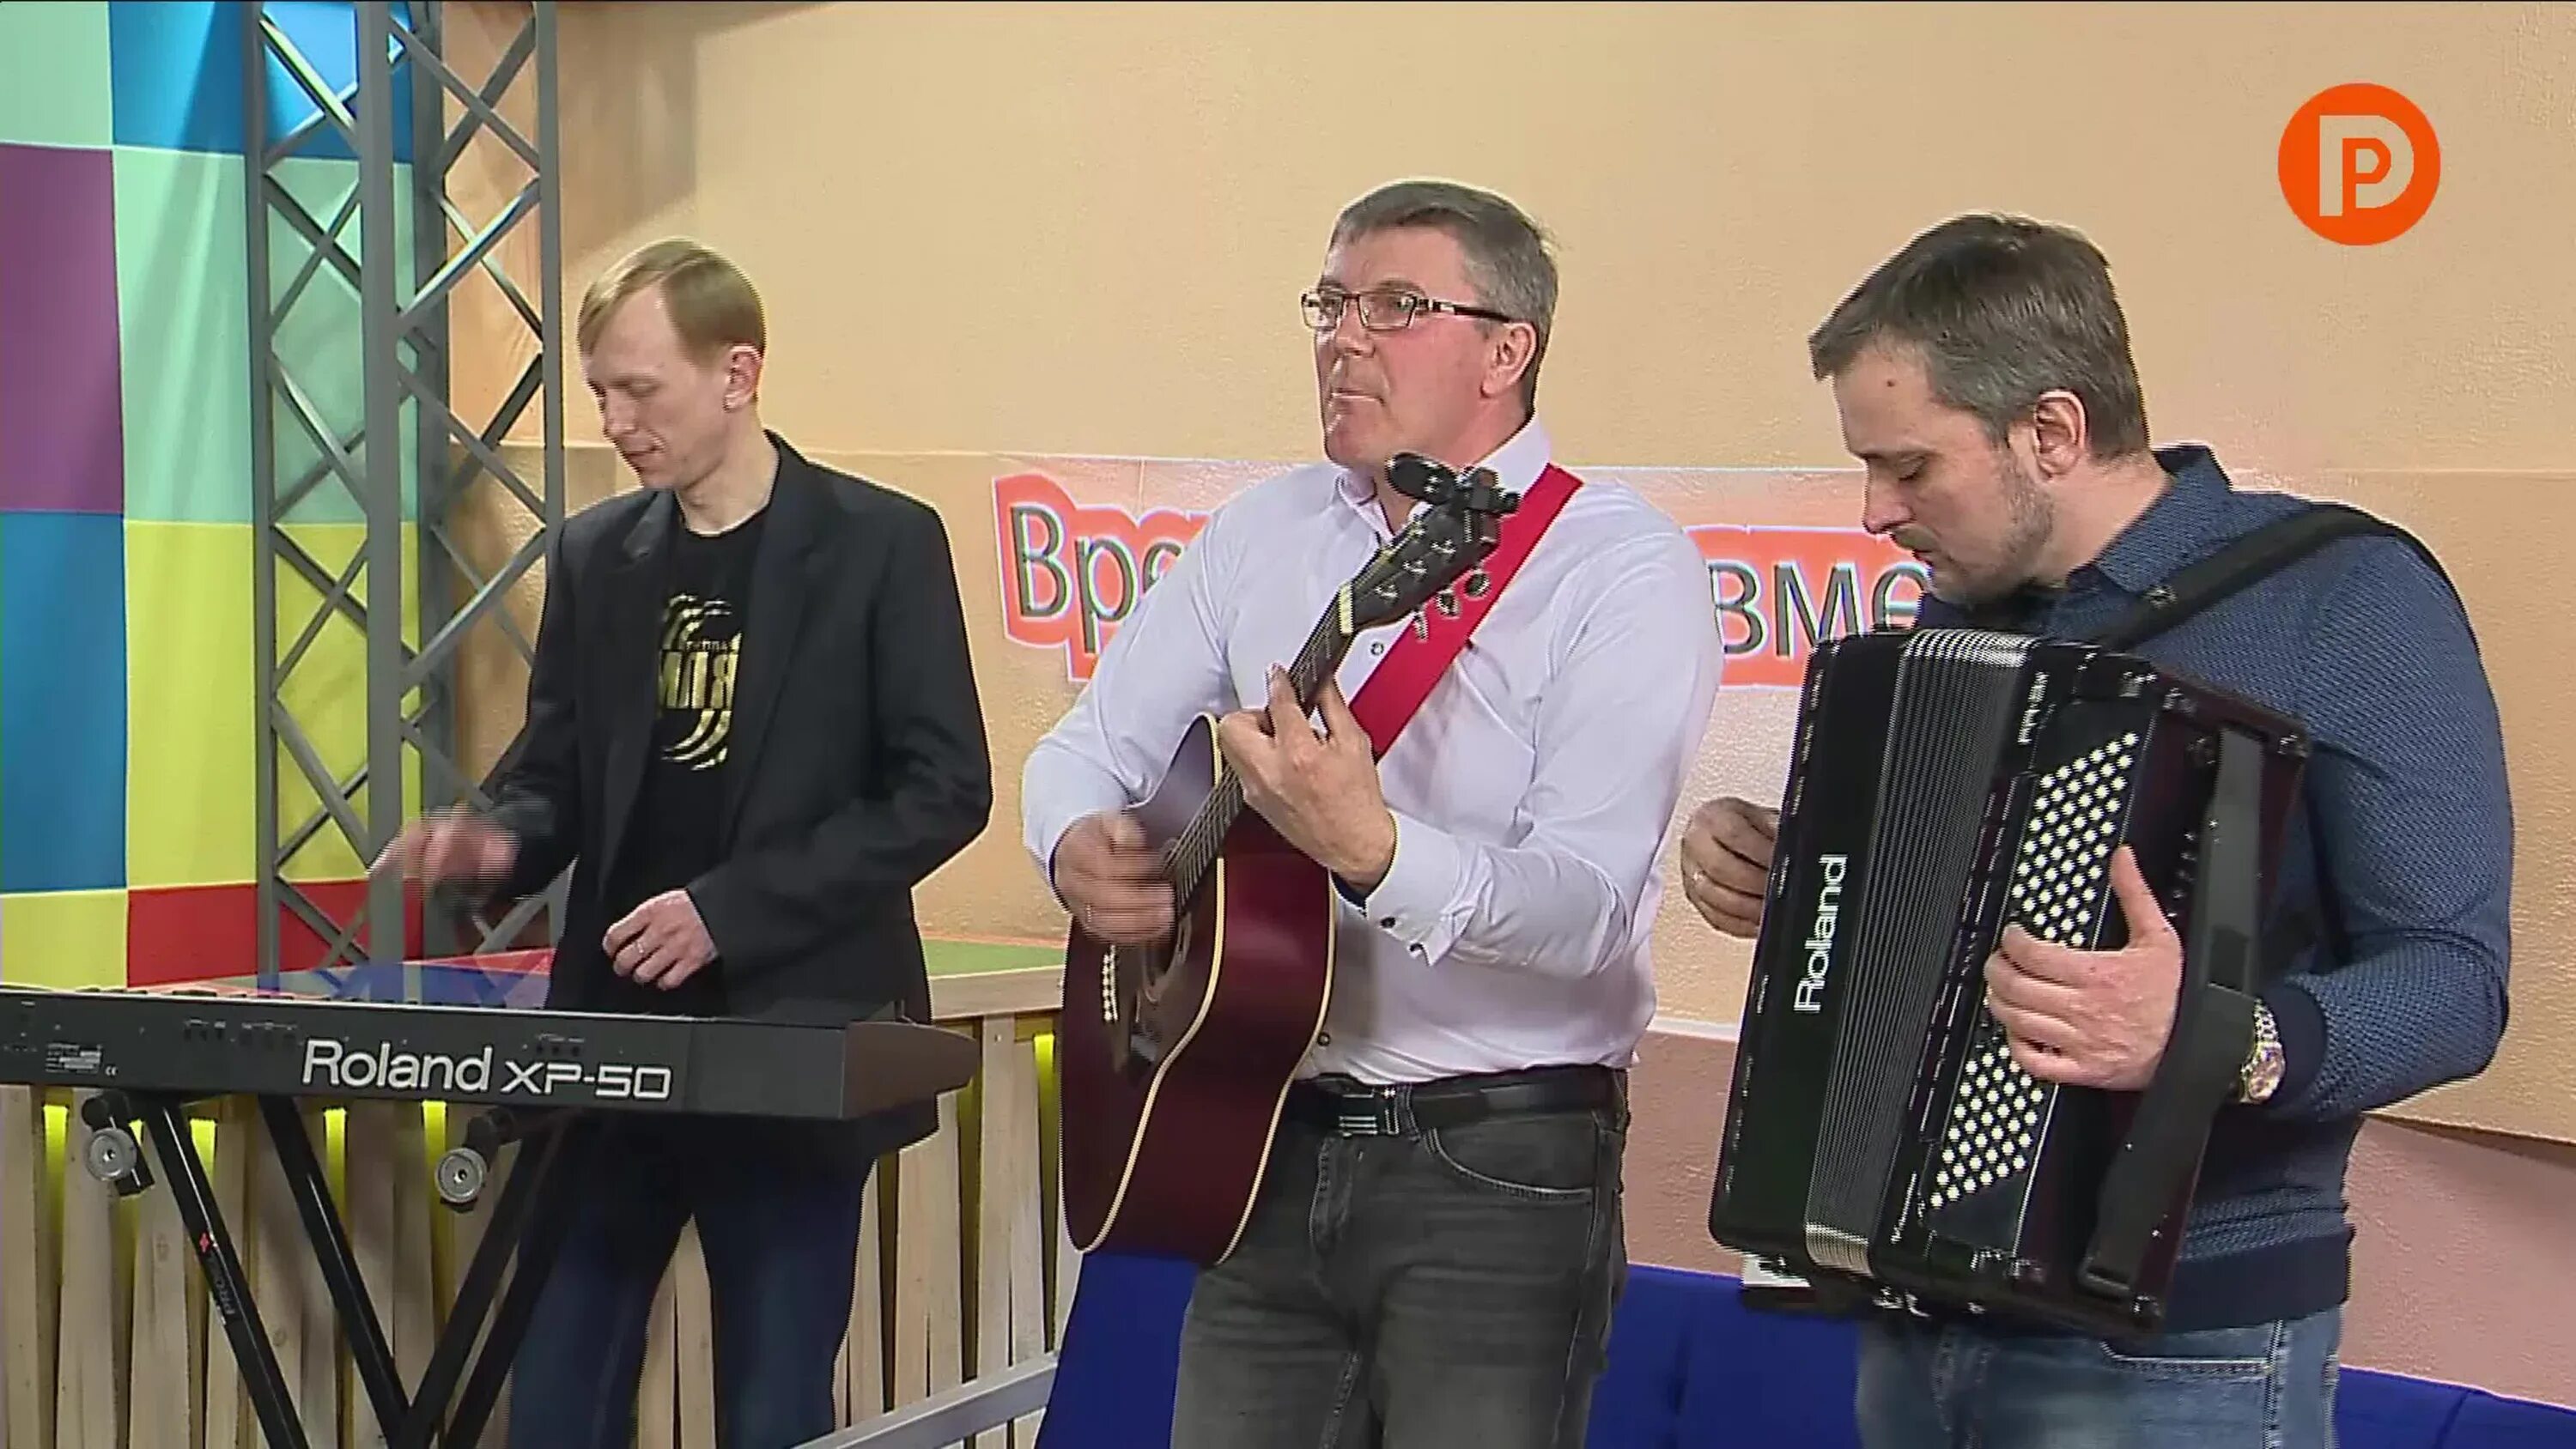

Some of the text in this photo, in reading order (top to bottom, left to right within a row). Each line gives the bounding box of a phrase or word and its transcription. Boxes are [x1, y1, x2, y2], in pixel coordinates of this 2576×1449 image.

[1794, 854, 1848, 1012] Roland
[301, 1038, 672, 1100] Roland XP-50
